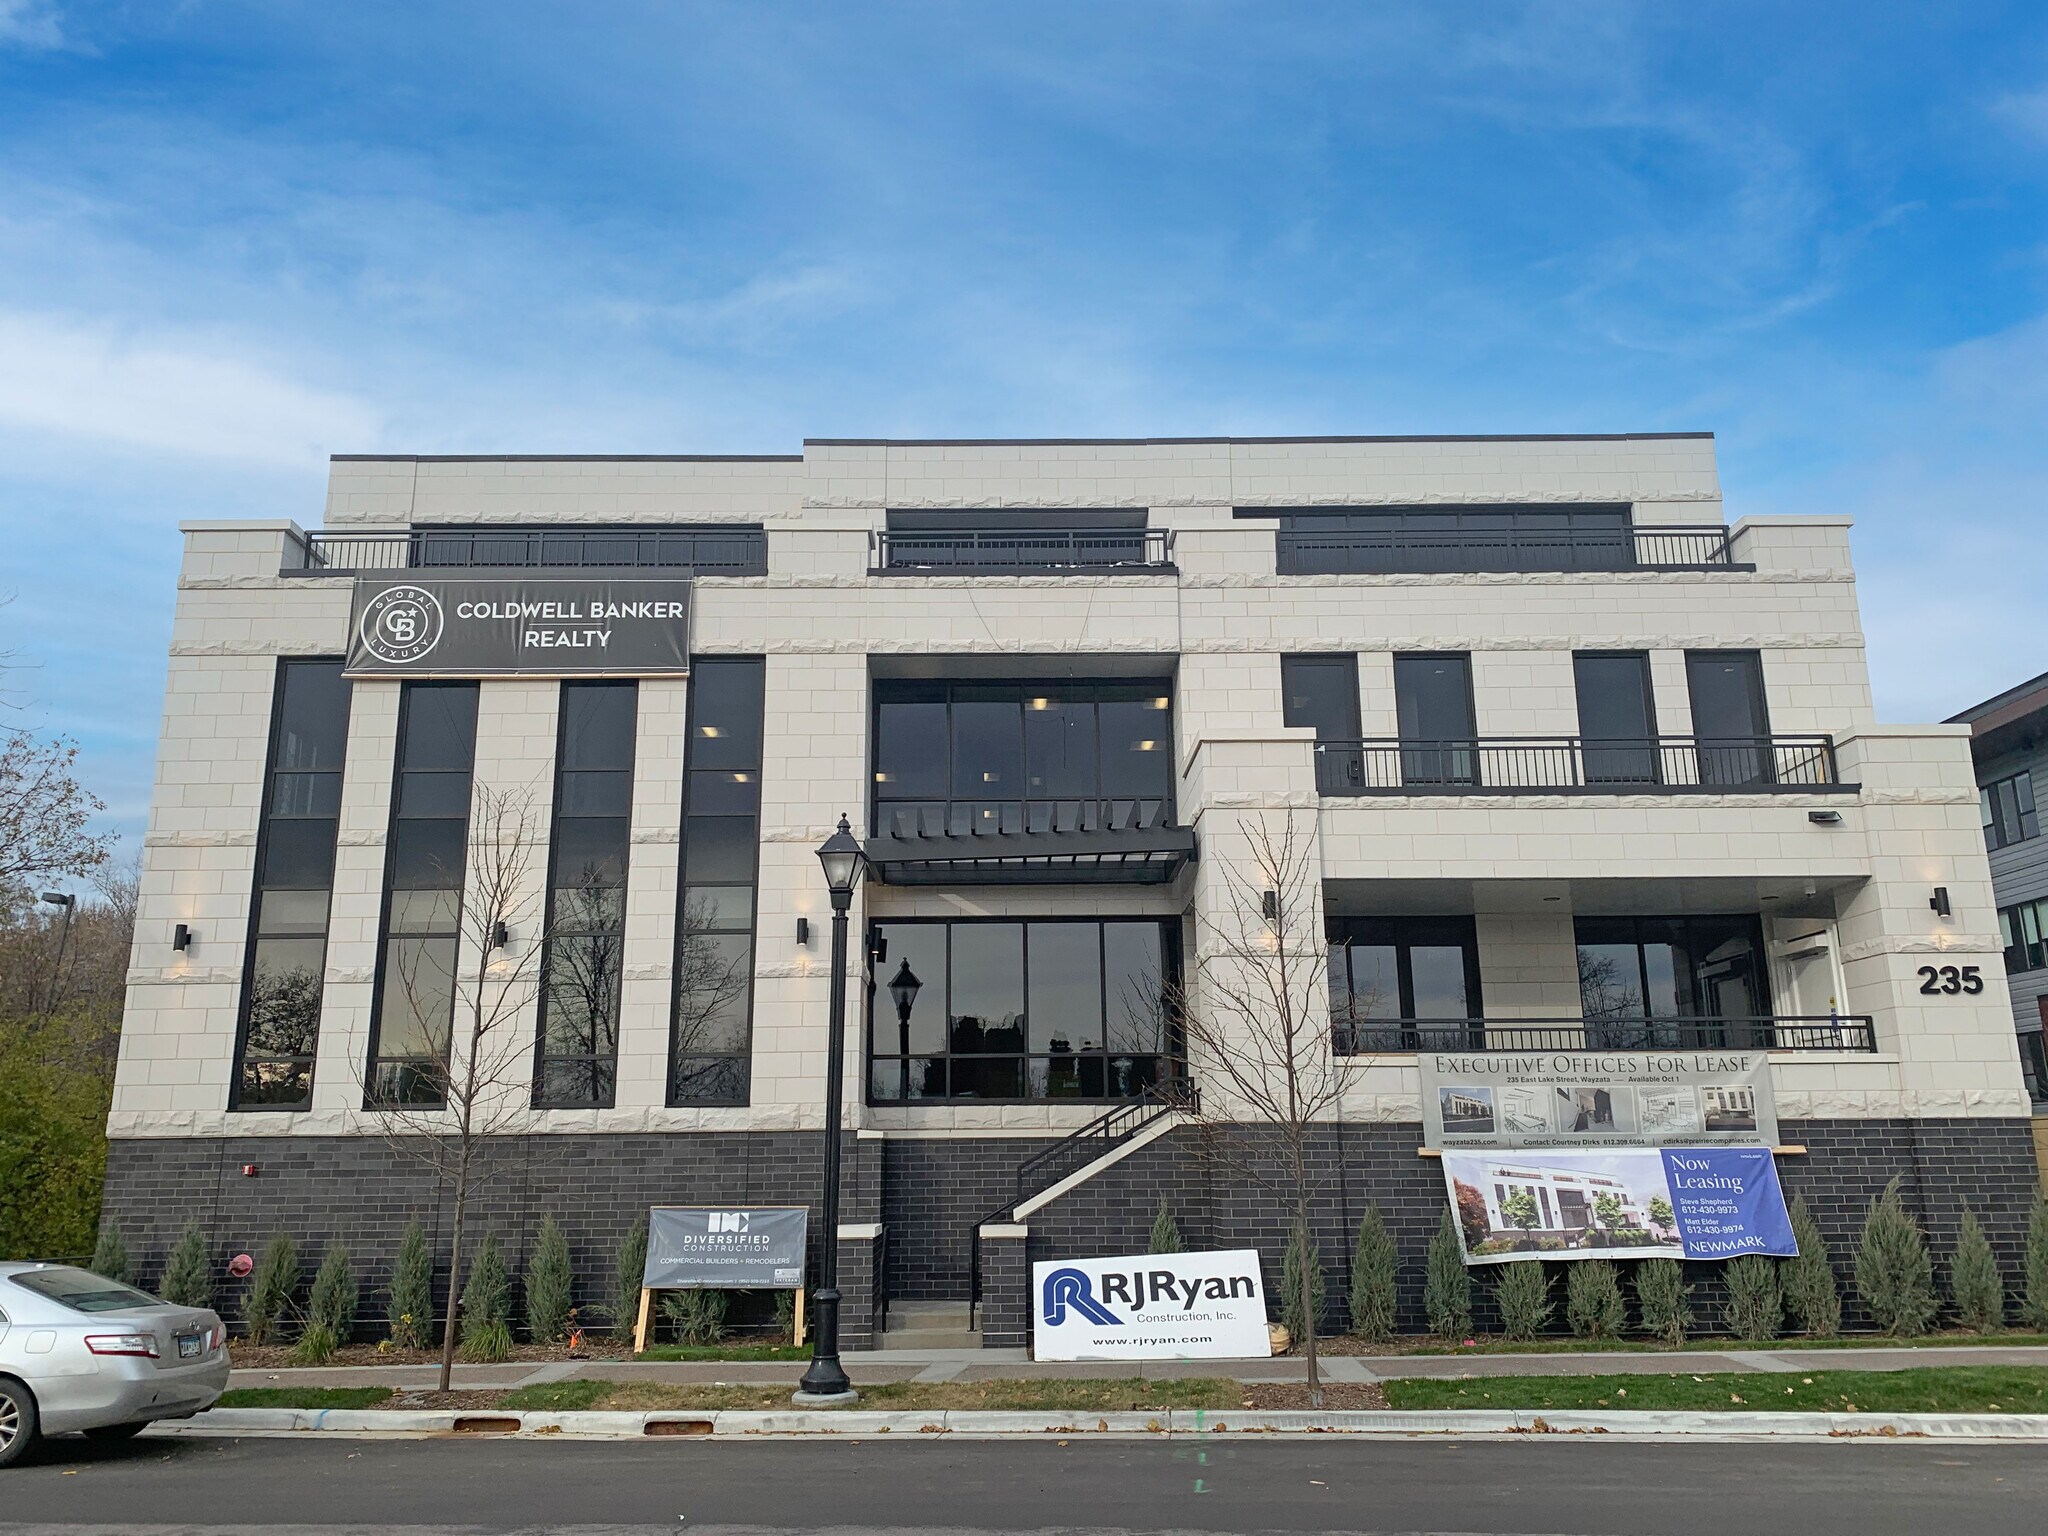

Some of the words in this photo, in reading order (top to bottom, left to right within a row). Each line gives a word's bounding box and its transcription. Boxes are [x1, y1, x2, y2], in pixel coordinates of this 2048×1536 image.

[376, 591, 432, 610] GLOBAL
[456, 601, 582, 619] COLDWELL
[590, 601, 683, 619] BANKER
[370, 638, 429, 658] LUXURY
[525, 630, 612, 648] REALTY
[1917, 965, 1984, 995] 235
[1435, 1055, 1546, 1074] EXECUTIVE
[1553, 1055, 1637, 1074] OFFICES
[1646, 1055, 1688, 1073] FOR
[1694, 1055, 1751, 1073] LEASE
[1552, 1138, 1581, 1146] Courtney
[1670, 1155, 1710, 1171] Now
[1674, 1173, 1744, 1194] Leasing
[1682, 1206, 1738, 1214] 612-430-9973
[1700, 1198, 1732, 1206] Shepherd
[1687, 1224, 1744, 1234] 612-430-9974
[684, 1236, 770, 1244] DIVERSIFIED
[1690, 1235, 1766, 1253] NEWMARK
[1101, 1270, 1255, 1311] RJRyan
[1136, 1311, 1212, 1323] Construction,
[1216, 1311, 1236, 1321] Inc.
[1092, 1335, 1212, 1346] www.rjryan.com
